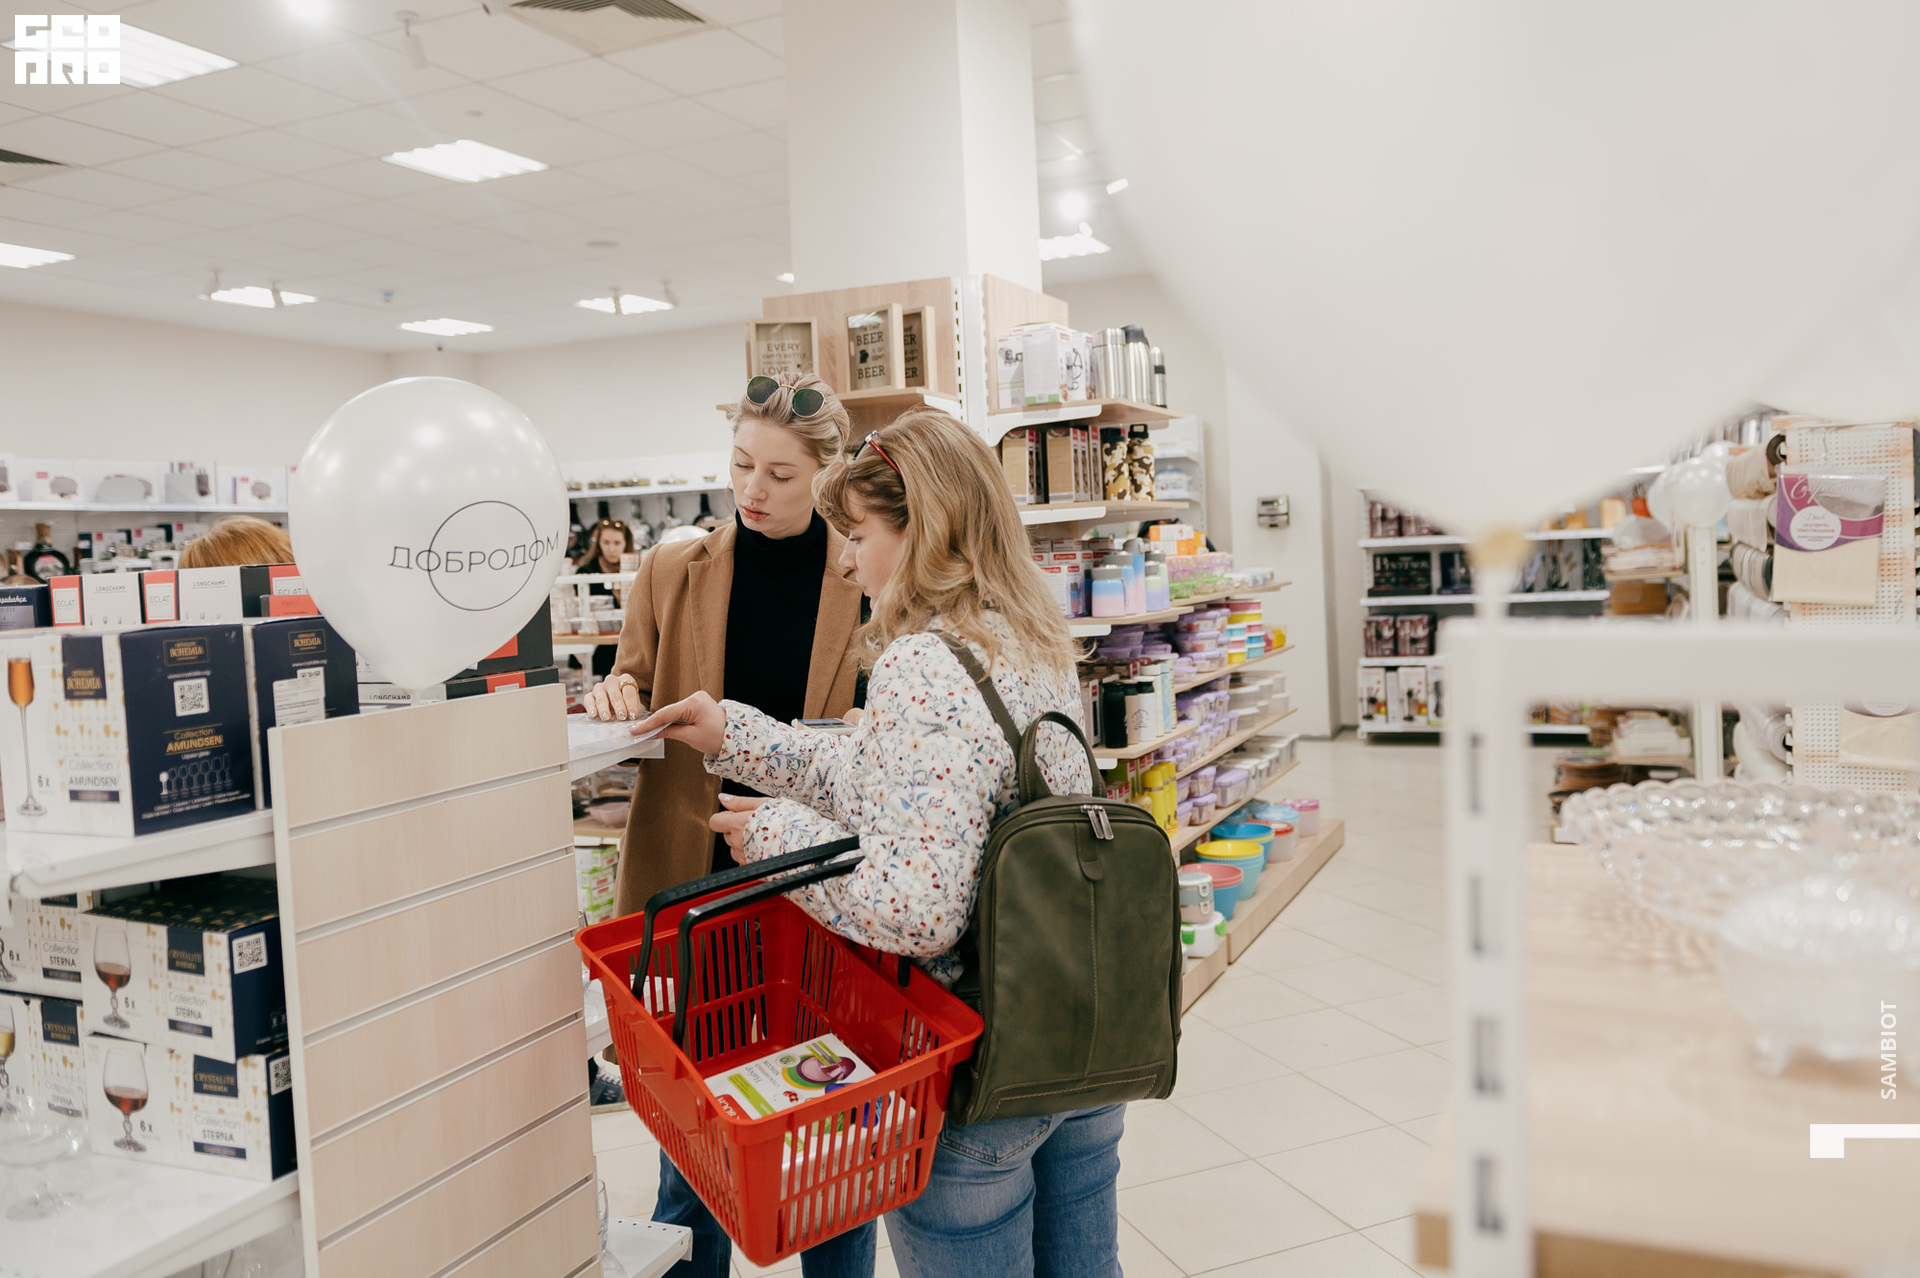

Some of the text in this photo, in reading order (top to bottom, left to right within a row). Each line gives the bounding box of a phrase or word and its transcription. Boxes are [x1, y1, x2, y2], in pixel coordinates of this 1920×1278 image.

[855, 331, 884, 346] BEER
[766, 342, 801, 352] EVERY
[857, 365, 886, 380] BEER
[387, 530, 560, 574] ДОБРОДОМ
[56, 599, 76, 608] ECLAT
[149, 594, 170, 604] ECLAT
[293, 637, 322, 648] BOHEMIA
[169, 646, 205, 658] BOHEMIA
[66, 676, 103, 690] BOHEMIA
[173, 728, 215, 741] Collection
[165, 735, 224, 753] AMUNDSEN
[68, 759, 114, 772] Collection
[37, 775, 44, 788] 6
[68, 775, 117, 788] AMUNDSEN
[9, 950, 15, 961] 6
[49, 955, 77, 967] STERNA
[168, 991, 208, 1007] Collection
[174, 1007, 203, 1021] STERNA
[194, 1072, 236, 1086] CRYSTALITE
[139, 1120, 146, 1132] 6
[193, 1114, 242, 1130] Collection
[201, 1129, 236, 1143] STERNA
